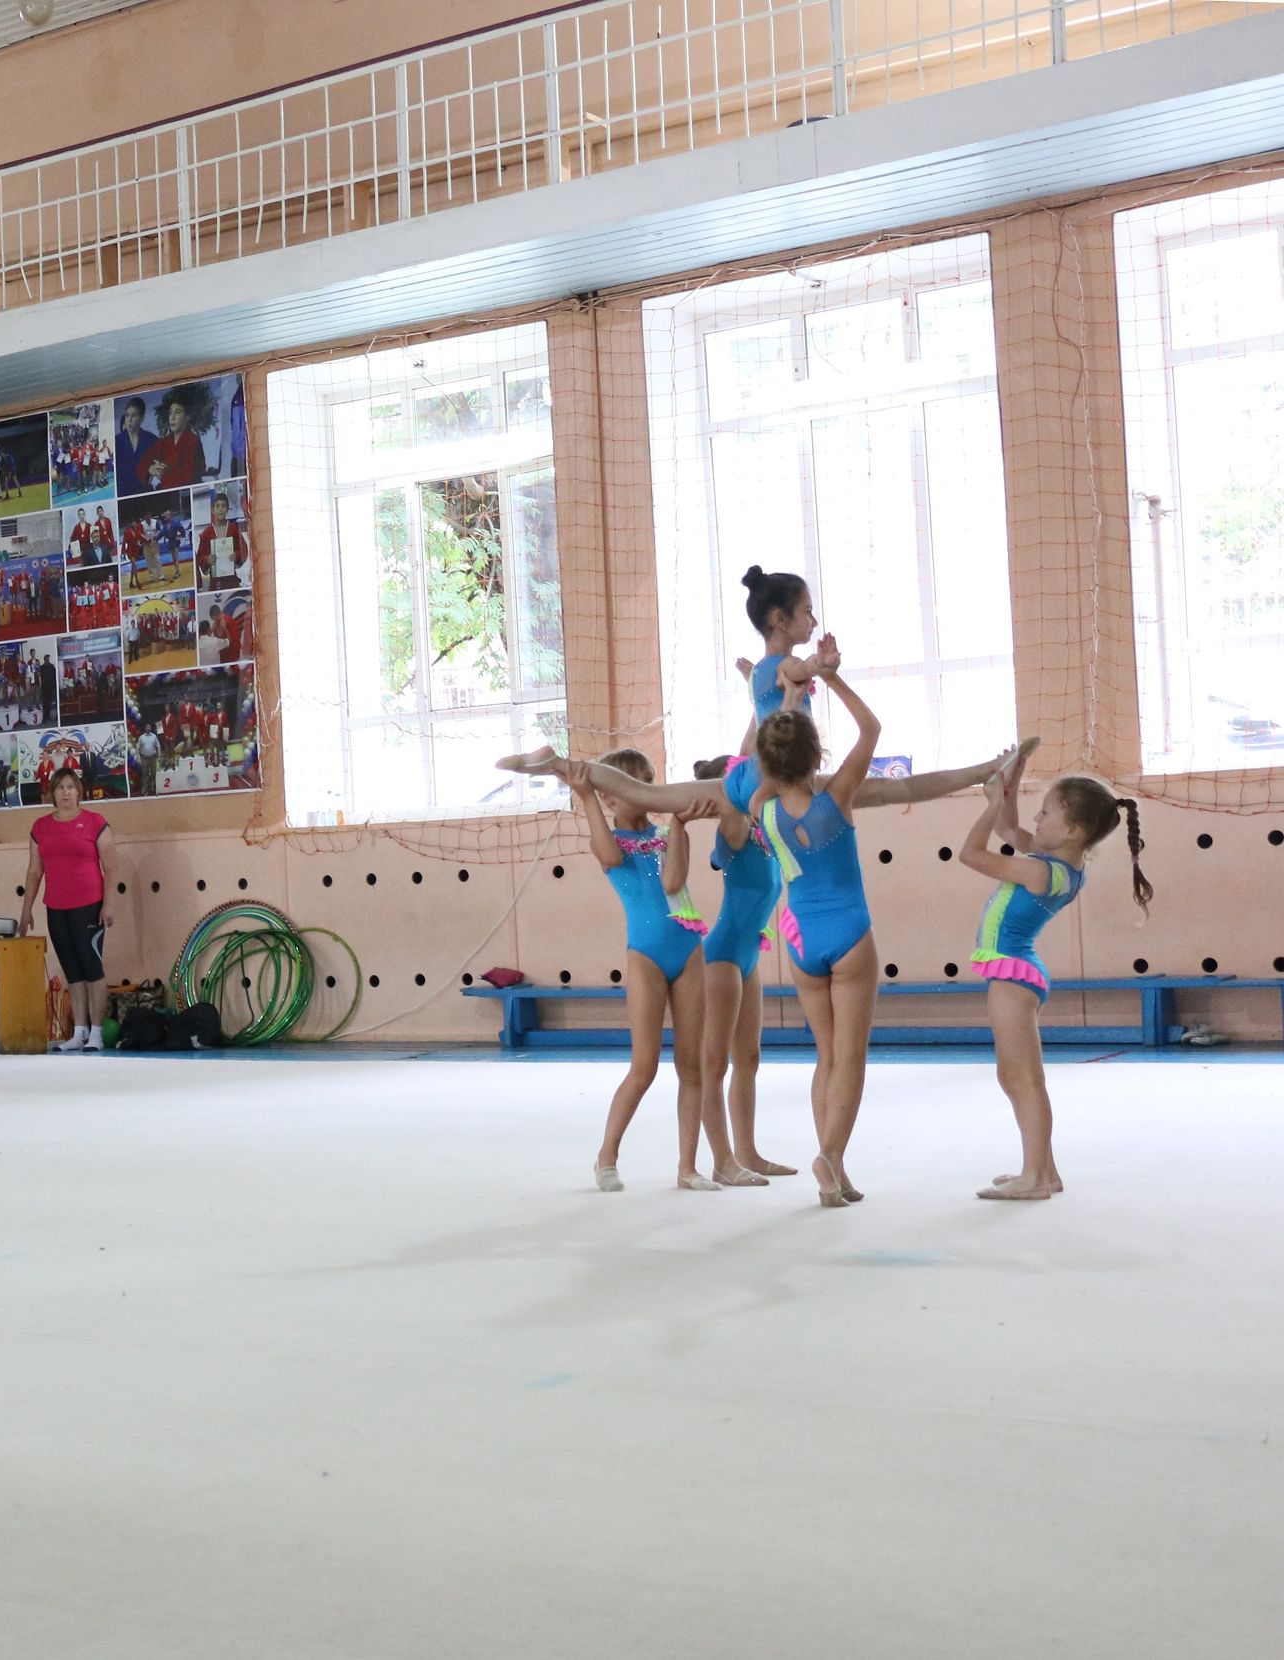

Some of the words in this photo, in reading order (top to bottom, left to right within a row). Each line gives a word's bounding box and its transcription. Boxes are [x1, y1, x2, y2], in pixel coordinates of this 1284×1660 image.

[5, 713, 10, 726] 1
[32, 714, 38, 724] 3
[188, 760, 194, 771] 1
[163, 778, 171, 788] 2
[212, 773, 219, 783] 3
